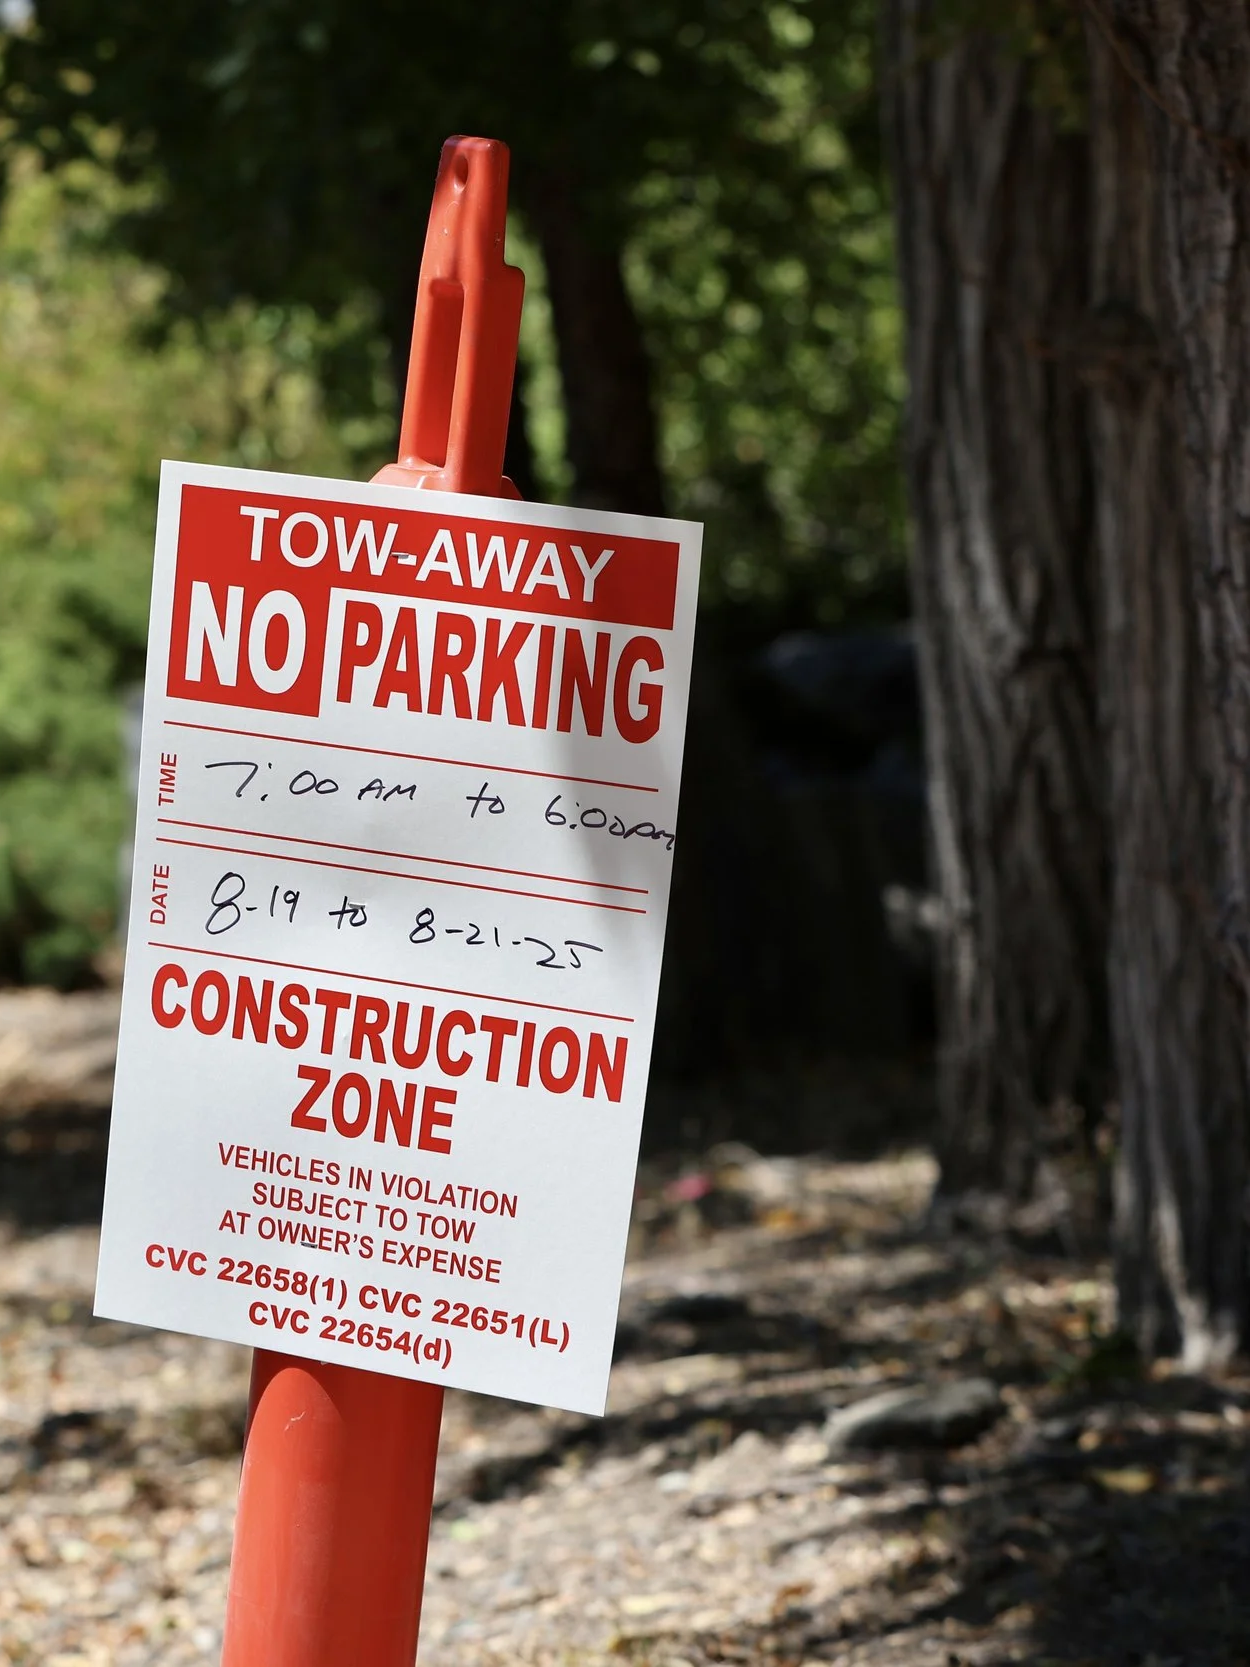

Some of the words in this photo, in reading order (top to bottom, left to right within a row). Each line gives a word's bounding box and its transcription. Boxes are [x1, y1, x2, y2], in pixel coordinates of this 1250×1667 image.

[239, 506, 615, 603] TOW-AWAY
[184, 580, 307, 694] NO
[336, 599, 666, 744] PARKING
[158, 752, 177, 806] TIME
[357, 778, 417, 801] AM
[466, 782, 505, 818] to
[150, 864, 170, 925] DATE
[205, 872, 300, 935] 8-19
[328, 896, 368, 929] to
[409, 908, 603, 969] 8-21-25
[150, 963, 629, 1103] CONSTRUCTION
[291, 1064, 458, 1155] ZONE
[218, 1143, 340, 1185] VEHICLES
[348, 1166, 372, 1192] IN
[381, 1172, 518, 1218] VIOLATION
[252, 1182, 367, 1223] SUBJECT
[375, 1204, 408, 1231] TO
[416, 1212, 476, 1244] TOW
[218, 1210, 251, 1235] AT
[258, 1216, 374, 1259] OWNER'S
[382, 1240, 502, 1283] EXPENSE
[146, 1244, 207, 1276] CVC
[217, 1257, 348, 1310] 22658(1)
[359, 1285, 421, 1318] CVC
[432, 1298, 570, 1352] 22651(L)
[248, 1301, 310, 1334] CVC
[319, 1315, 452, 1369] 22654(d)
